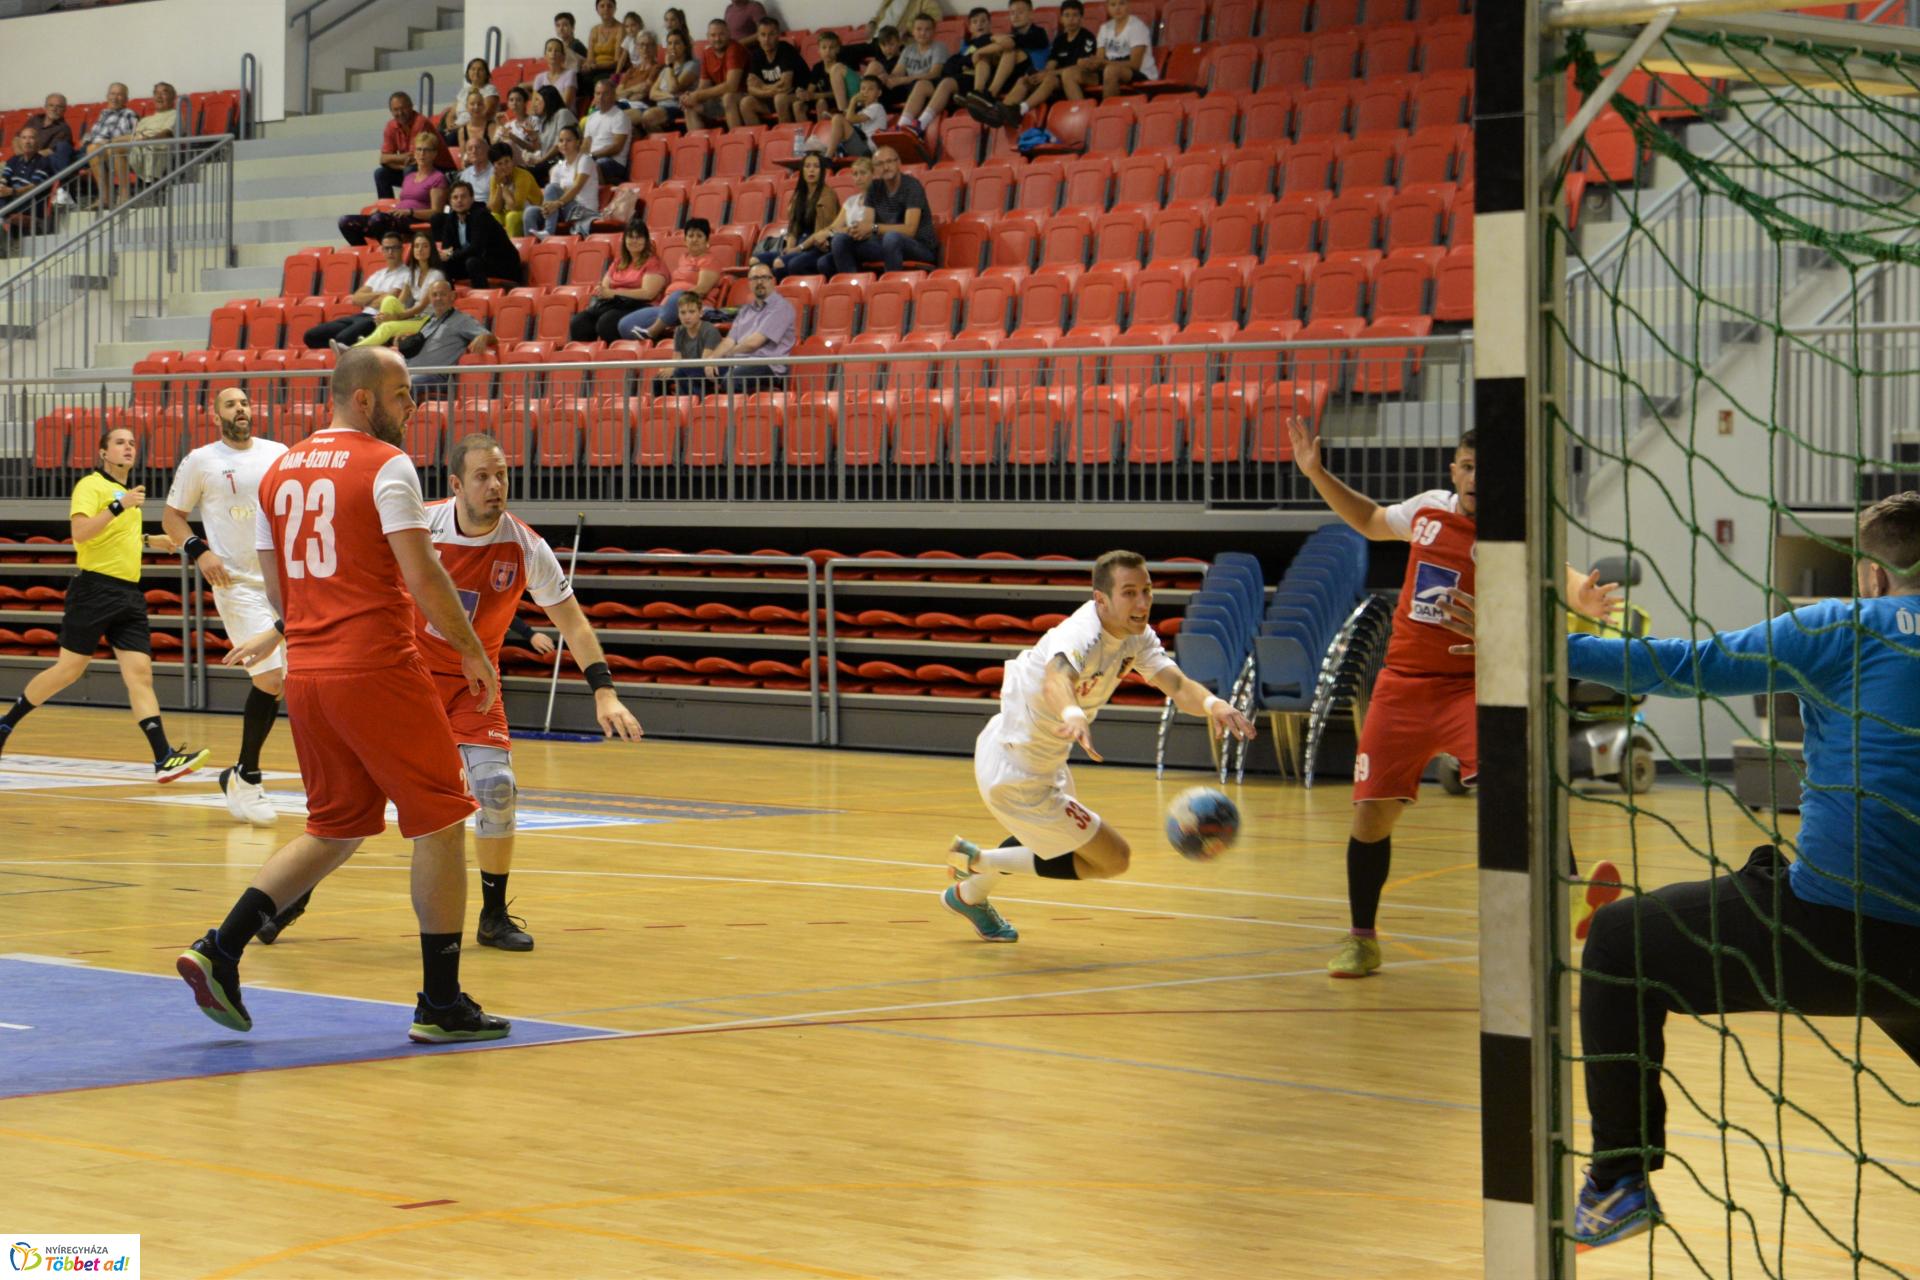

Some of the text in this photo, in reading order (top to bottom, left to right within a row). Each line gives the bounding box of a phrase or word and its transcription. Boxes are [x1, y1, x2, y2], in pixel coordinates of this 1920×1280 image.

[331, 450, 350, 469] KC
[274, 478, 337, 579] 23
[1412, 516, 1442, 546] 69
[1065, 800, 1091, 830] 33
